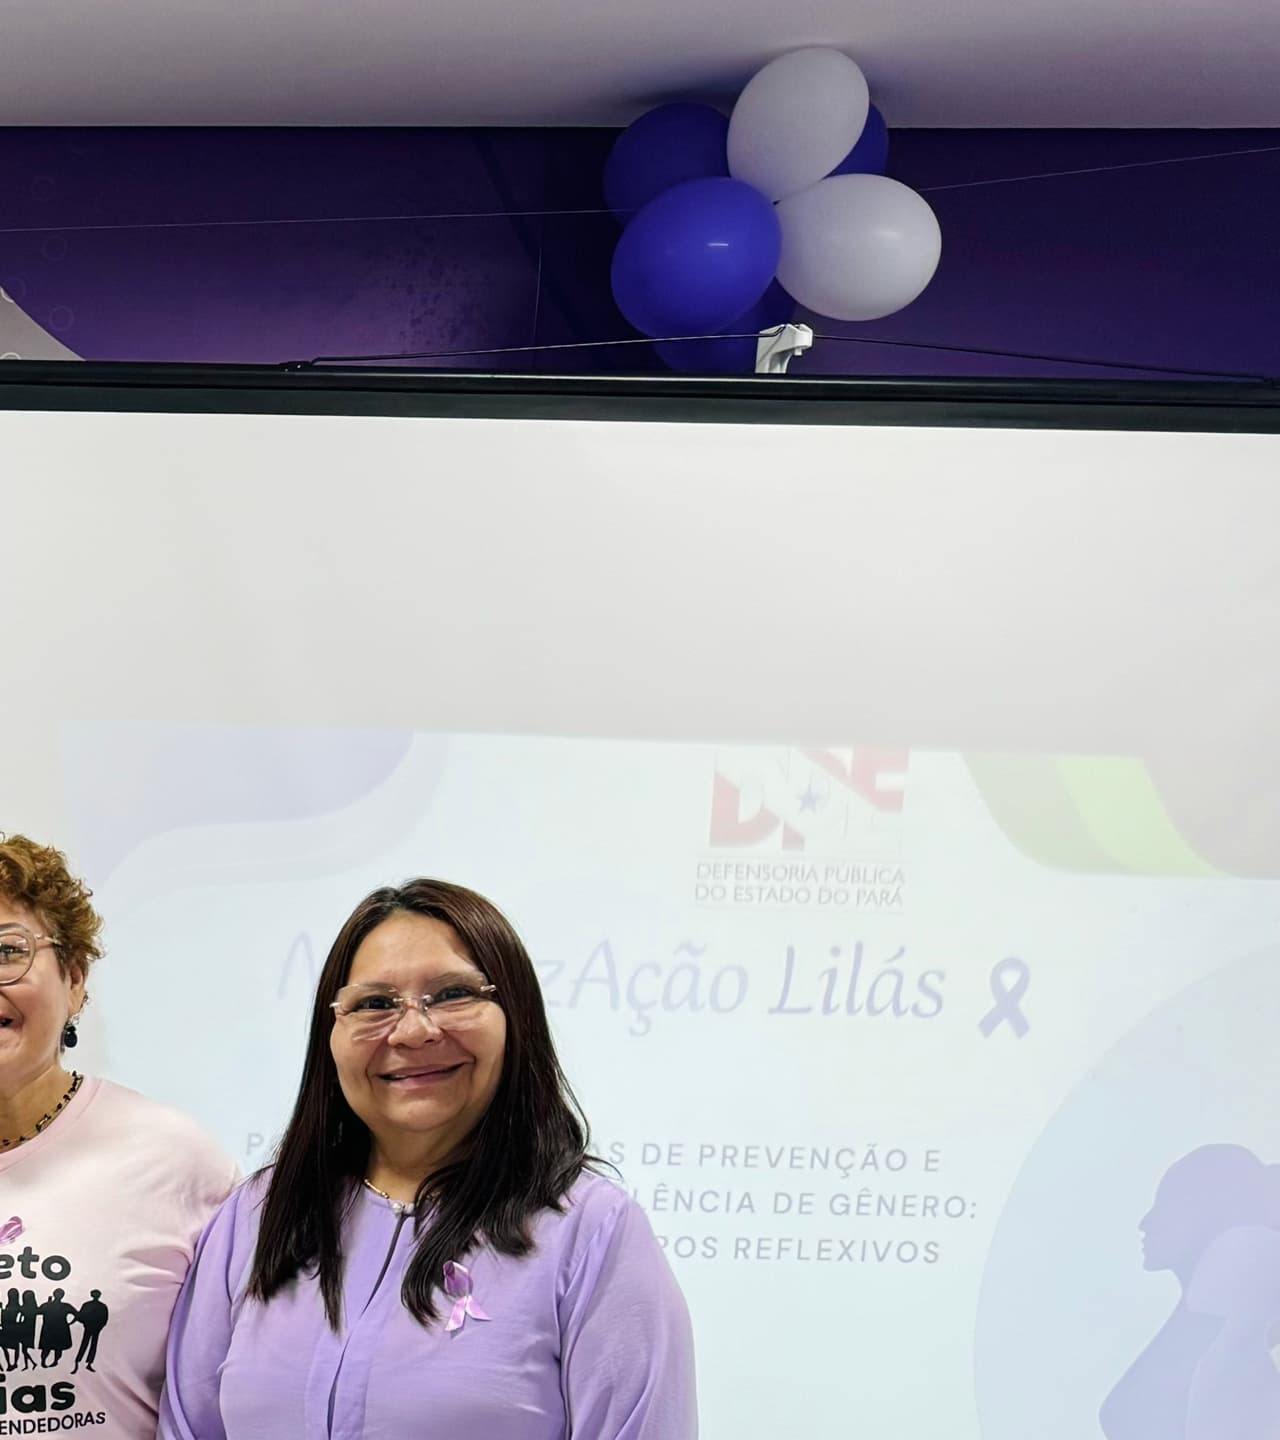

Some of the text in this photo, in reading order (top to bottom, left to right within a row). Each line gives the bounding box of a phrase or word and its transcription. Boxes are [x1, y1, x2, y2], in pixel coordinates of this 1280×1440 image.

[697, 861, 906, 885] DEFENSORIA PÚBLICA
[695, 884, 904, 908] DO ESTADO DO PARÁ
[768, 940, 948, 1019] Lilás
[641, 1142, 684, 1166] DE
[699, 1143, 907, 1179] PREVENÇÃO
[924, 1149, 941, 1172] E
[773, 1192, 814, 1215] DE
[829, 1187, 977, 1219] GÊNERO:
[734, 1237, 940, 1264] REFLEXIVOS
